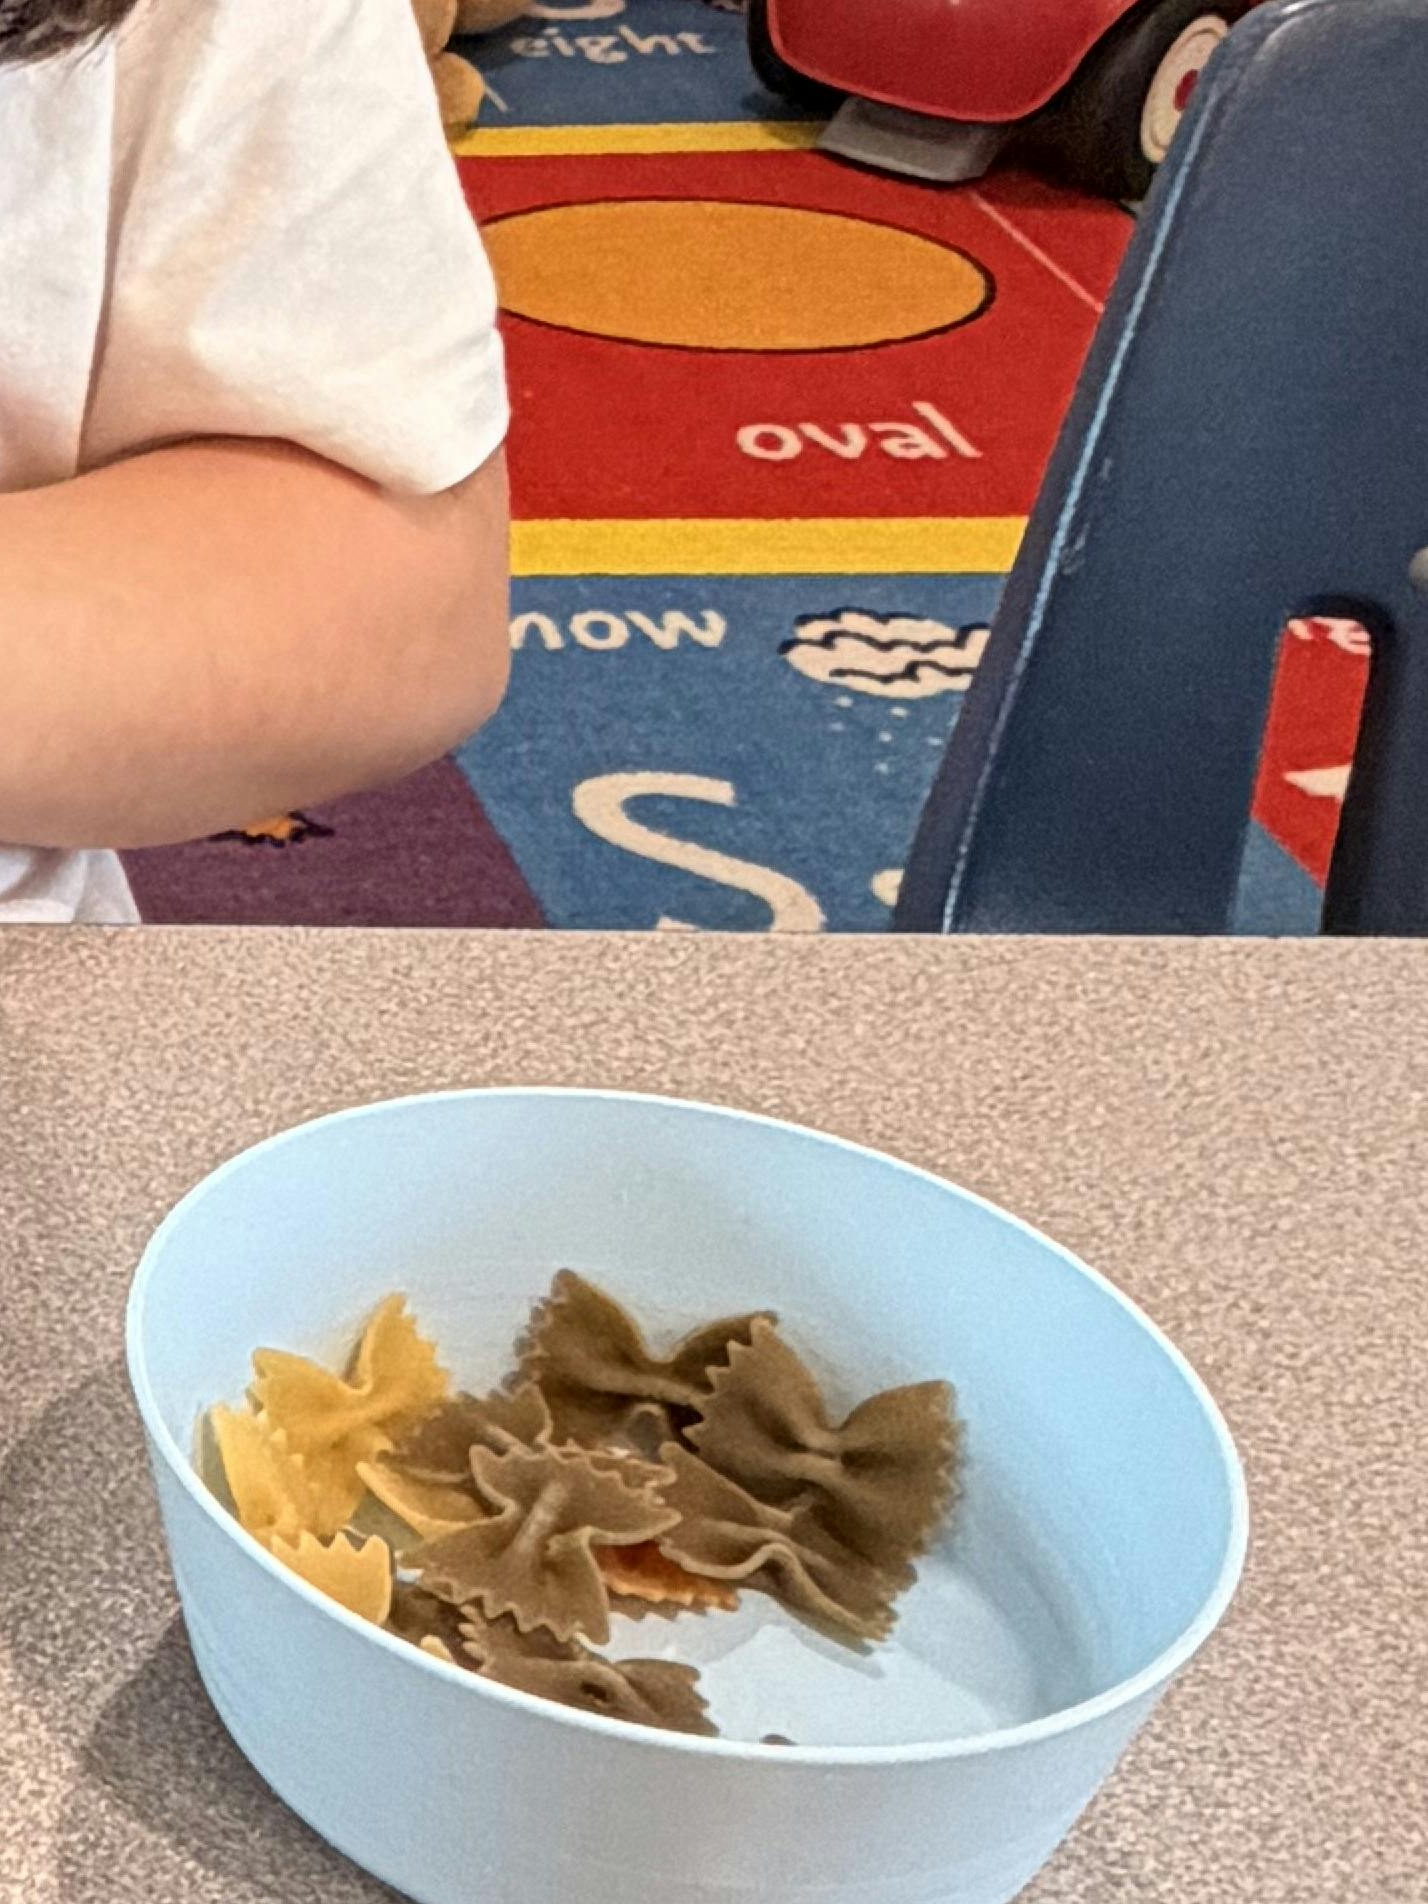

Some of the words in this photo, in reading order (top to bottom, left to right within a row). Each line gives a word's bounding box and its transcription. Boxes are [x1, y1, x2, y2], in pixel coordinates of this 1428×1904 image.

[509, 24, 717, 64] eight
[736, 401, 983, 461] oval
[510, 606, 728, 652] now
